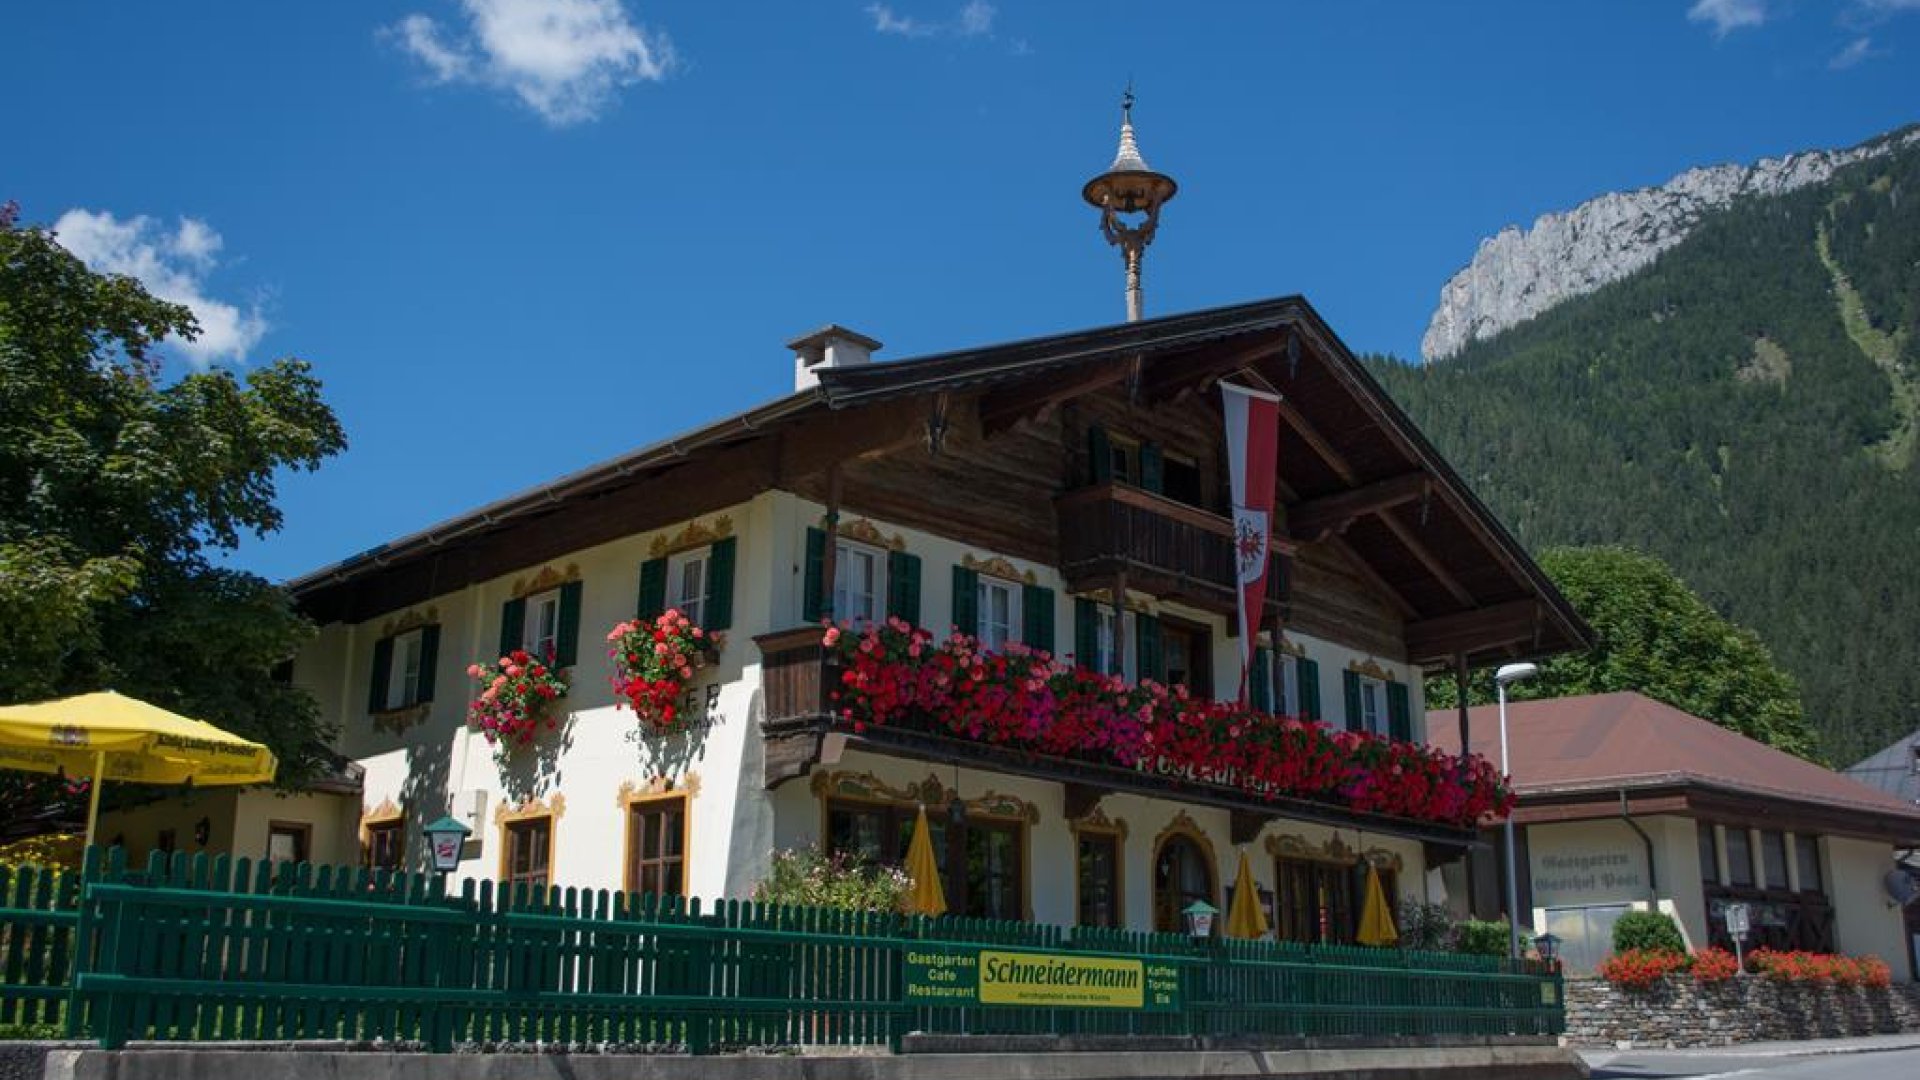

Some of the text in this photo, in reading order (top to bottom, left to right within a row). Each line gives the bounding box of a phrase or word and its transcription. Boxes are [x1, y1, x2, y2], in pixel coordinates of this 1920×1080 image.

[1601, 872, 1639, 888] Post
[907, 951, 976, 968] Gastgarten
[984, 956, 1139, 989] Schneidermann
[1147, 965, 1178, 978] Kaffee
[908, 983, 976, 998] Restaurant
[1147, 979, 1178, 991] Torten
